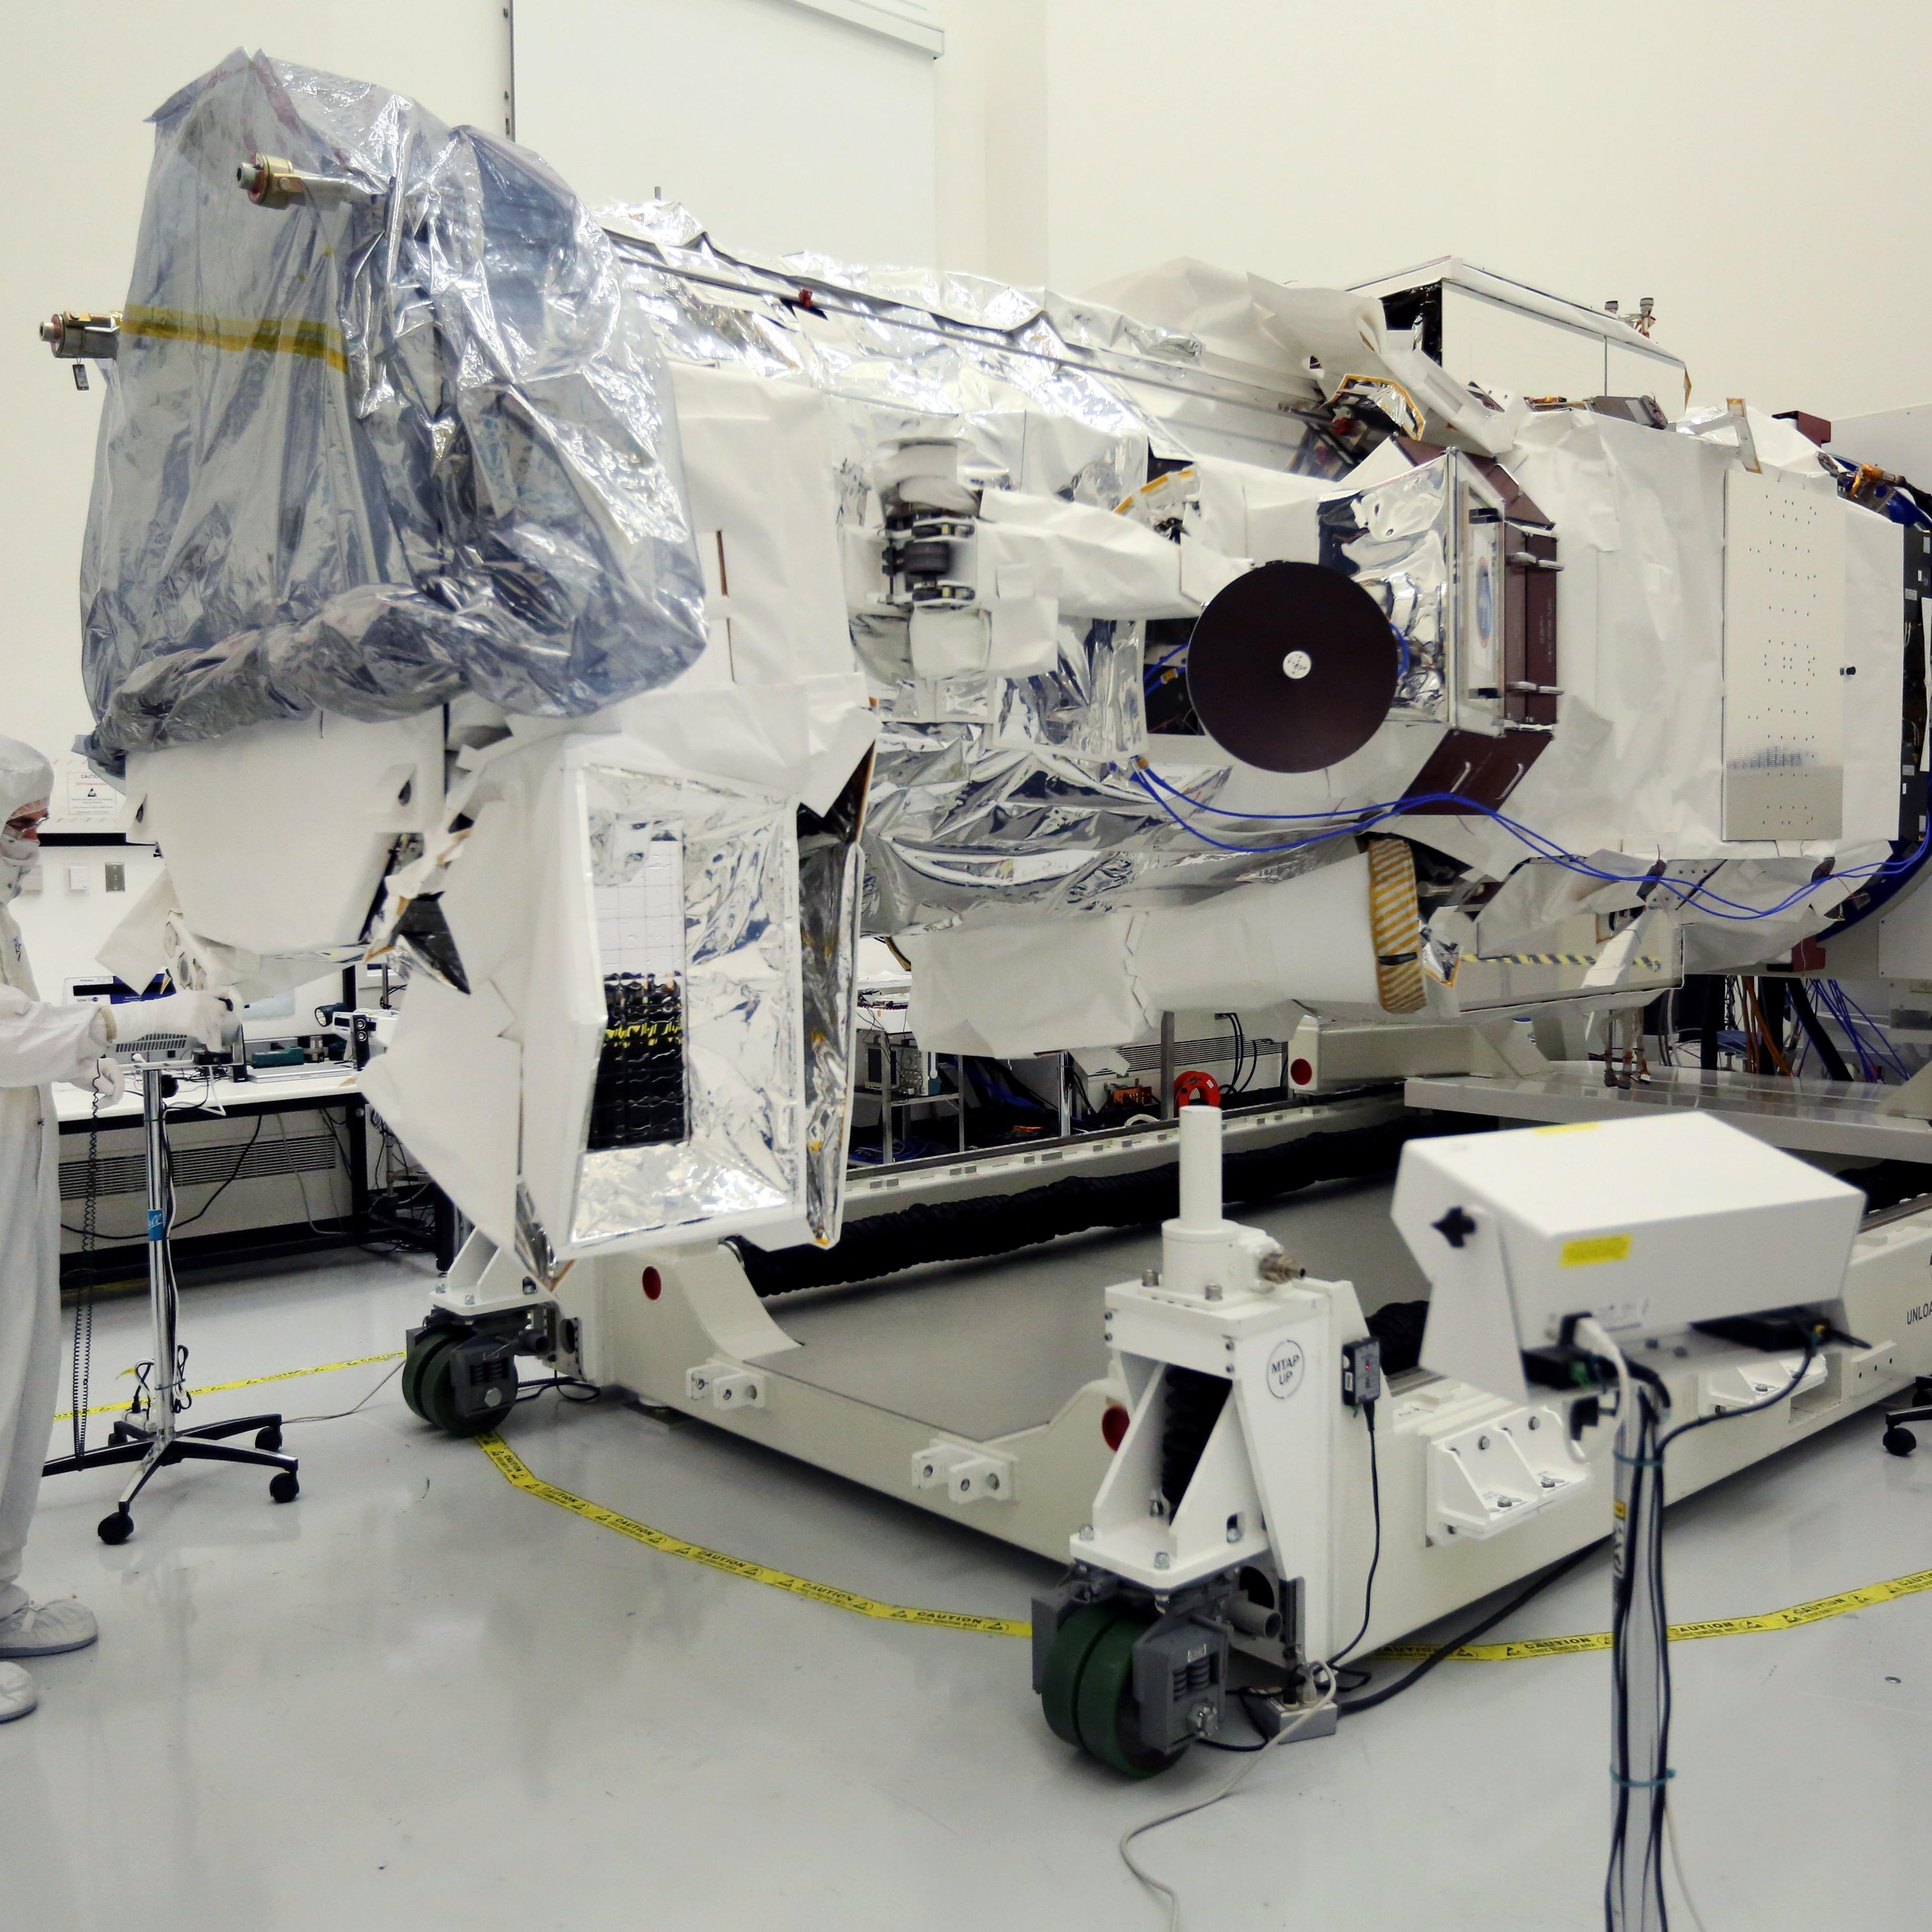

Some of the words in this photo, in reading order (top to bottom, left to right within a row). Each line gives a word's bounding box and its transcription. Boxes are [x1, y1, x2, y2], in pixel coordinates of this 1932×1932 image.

[1272, 1354, 1299, 1374] MTAP
[1279, 1371, 1293, 1385] UP
[615, 1518, 654, 1536] CAUTION
[917, 1612, 982, 1624] CAUTION
[1524, 1637, 1592, 1649] CAUTION
